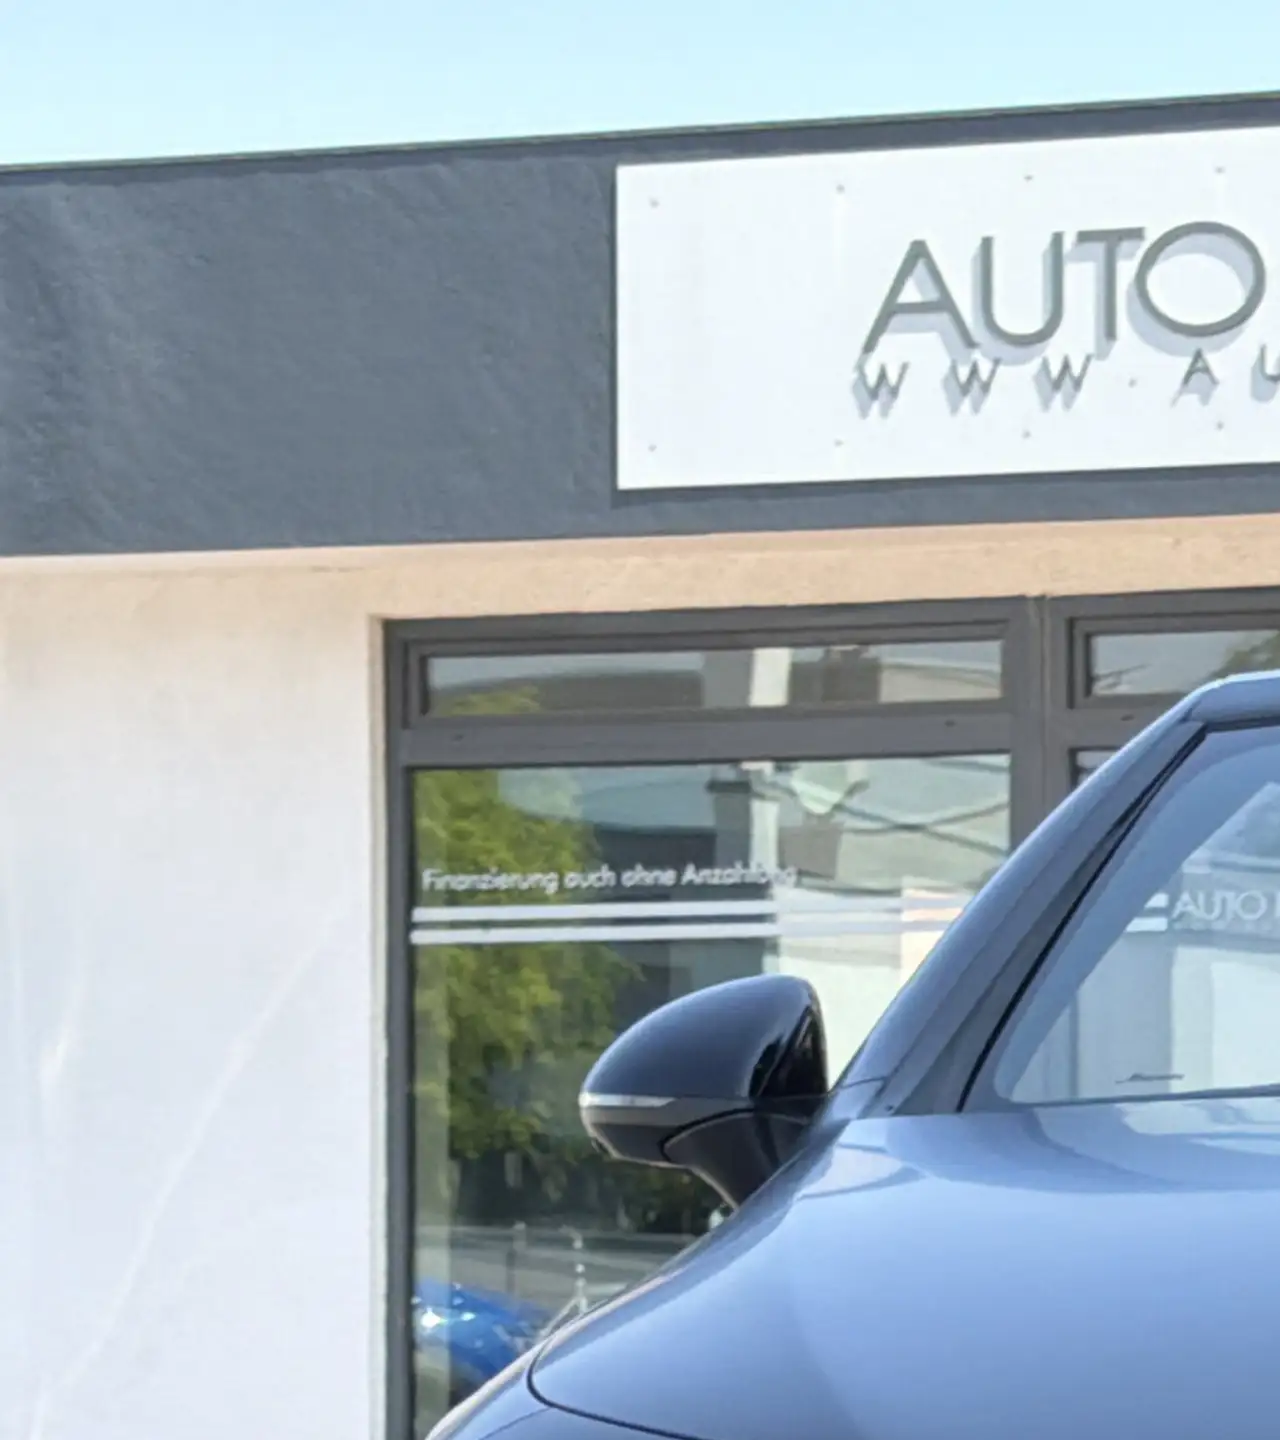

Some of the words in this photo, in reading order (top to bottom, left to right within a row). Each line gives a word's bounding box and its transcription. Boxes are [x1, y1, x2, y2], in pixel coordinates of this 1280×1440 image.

[862, 221, 1266, 354] AUTO
[564, 863, 617, 888] auch
[621, 862, 677, 887] ohne
[1172, 889, 1268, 920] AUTO
